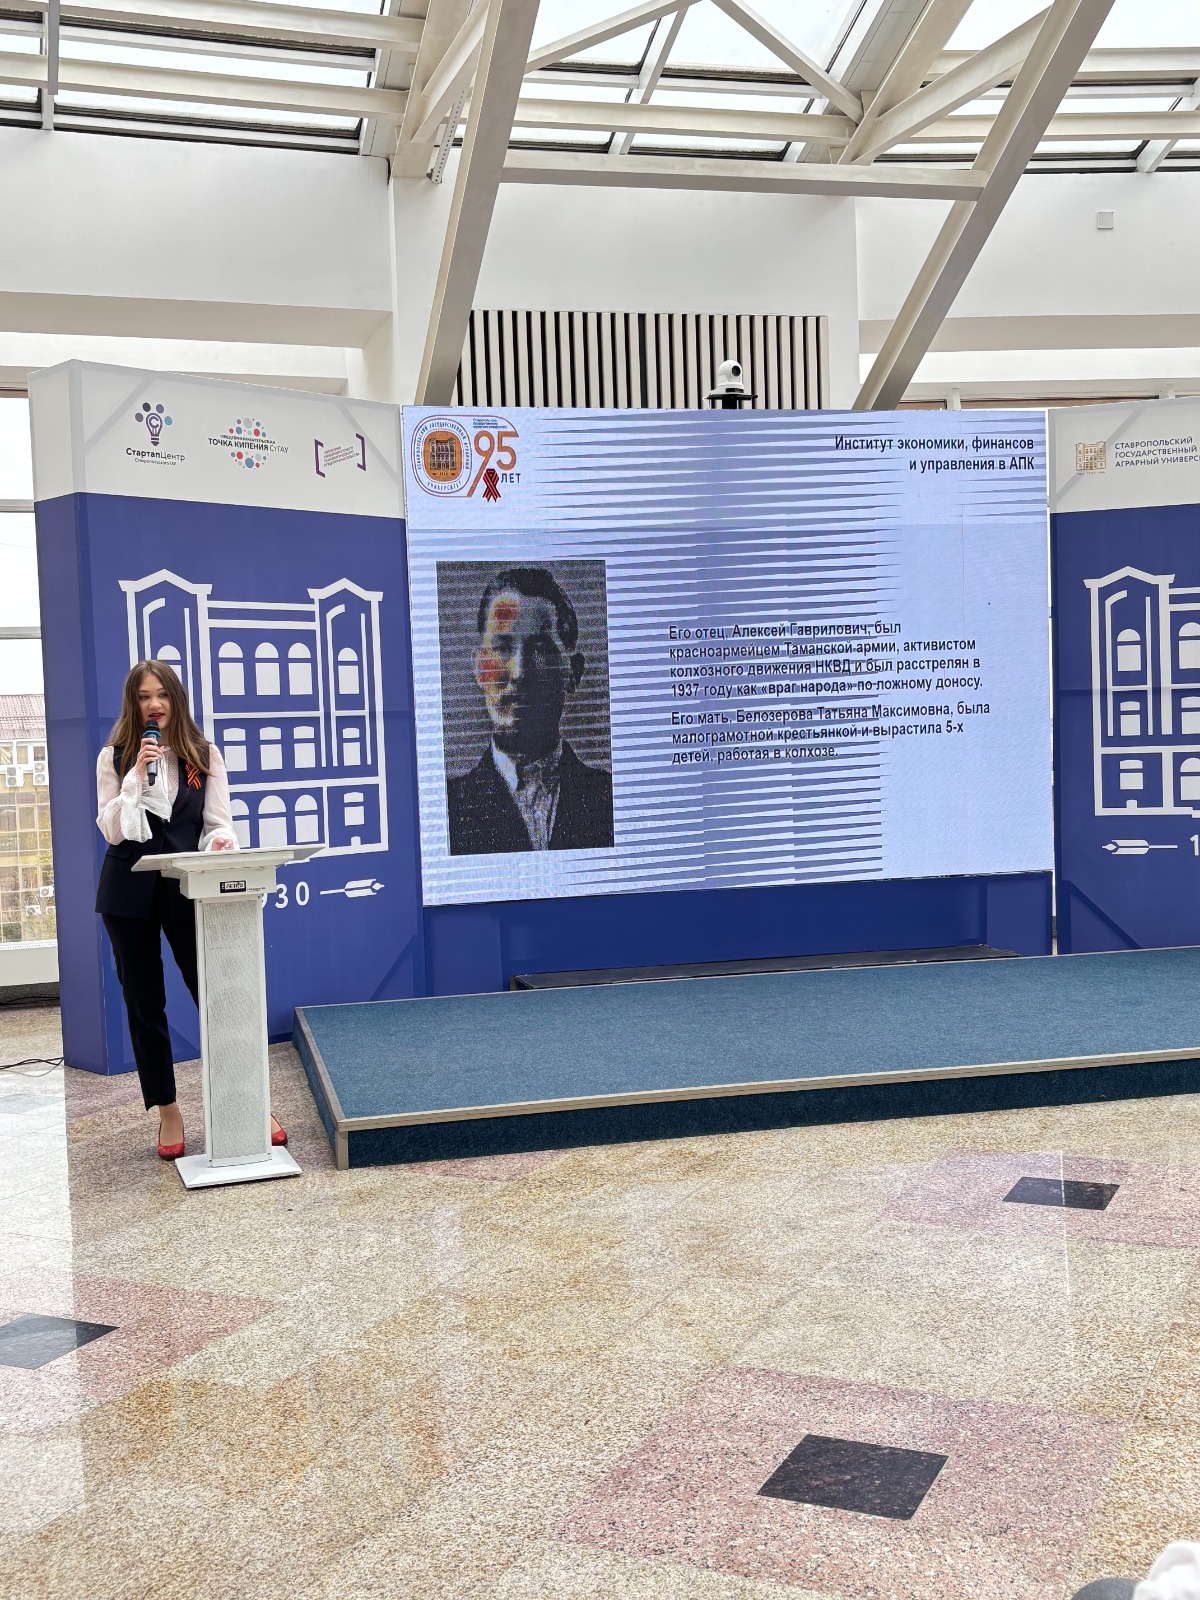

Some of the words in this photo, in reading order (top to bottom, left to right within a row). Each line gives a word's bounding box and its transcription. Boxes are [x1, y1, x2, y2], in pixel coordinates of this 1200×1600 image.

[208, 437, 233, 448] ТОЧКА
[234, 440, 269, 451] КИПЕНИЯ
[835, 435, 893, 453] Институт
[897, 436, 968, 451] экономики,
[971, 436, 1034, 454] финансов
[1114, 435, 1193, 450] СТАВРОПОЛЬСКИЙ
[1115, 445, 1198, 459] ГОСУДАРСТВЕННЫЙ
[125, 447, 186, 463] СтартапЦентр
[466, 430, 519, 498] 95
[1115, 457, 1159, 468] АГРАРНЫЙ
[1160, 454, 1200, 464] УНИВЕРС
[909, 458, 917, 470] и
[920, 457, 995, 474] управления
[999, 458, 1006, 470] в
[1009, 456, 1035, 470] АПК
[501, 473, 521, 483] ЛЕТ
[669, 626, 691, 640] Его
[695, 626, 729, 641] отец,
[732, 623, 786, 638] Алексей
[790, 622, 872, 639] Гаврилович,
[874, 620, 902, 635] был
[669, 643, 780, 661] красноармейцем
[784, 640, 853, 656] Таманской
[856, 642, 900, 656] армии,
[903, 639, 976, 652] активистом
[670, 664, 744, 677] колхозного
[747, 663, 811, 677] движения
[815, 659, 850, 674] НКВД
[854, 662, 862, 672] и
[866, 658, 893, 672] был
[896, 658, 969, 673] расстрелян
[973, 658, 981, 669] в
[671, 683, 700, 697] 1937
[704, 685, 733, 699] году
[737, 684, 757, 695] как
[761, 682, 797, 697] «враг
[800, 679, 853, 695] народа»
[857, 680, 873, 691] по
[876, 678, 932, 692] ложному
[935, 676, 983, 690] доносу.
[671, 712, 693, 725] Его
[698, 712, 733, 726] мать,
[736, 709, 813, 725] Белозерова
[817, 706, 868, 720] Татьяна
[871, 704, 954, 718] Максимовна,
[957, 701, 990, 715] была
[672, 727, 774, 746] малограмотной
[777, 724, 858, 743] крестьянкой
[861, 726, 868, 737] и
[873, 723, 942, 739] вырастила
[946, 720, 964, 733] 5-х
[672, 749, 714, 765] детей,
[717, 747, 769, 765] работая
[773, 748, 781, 759] в
[785, 745, 839, 759] колхозе.
